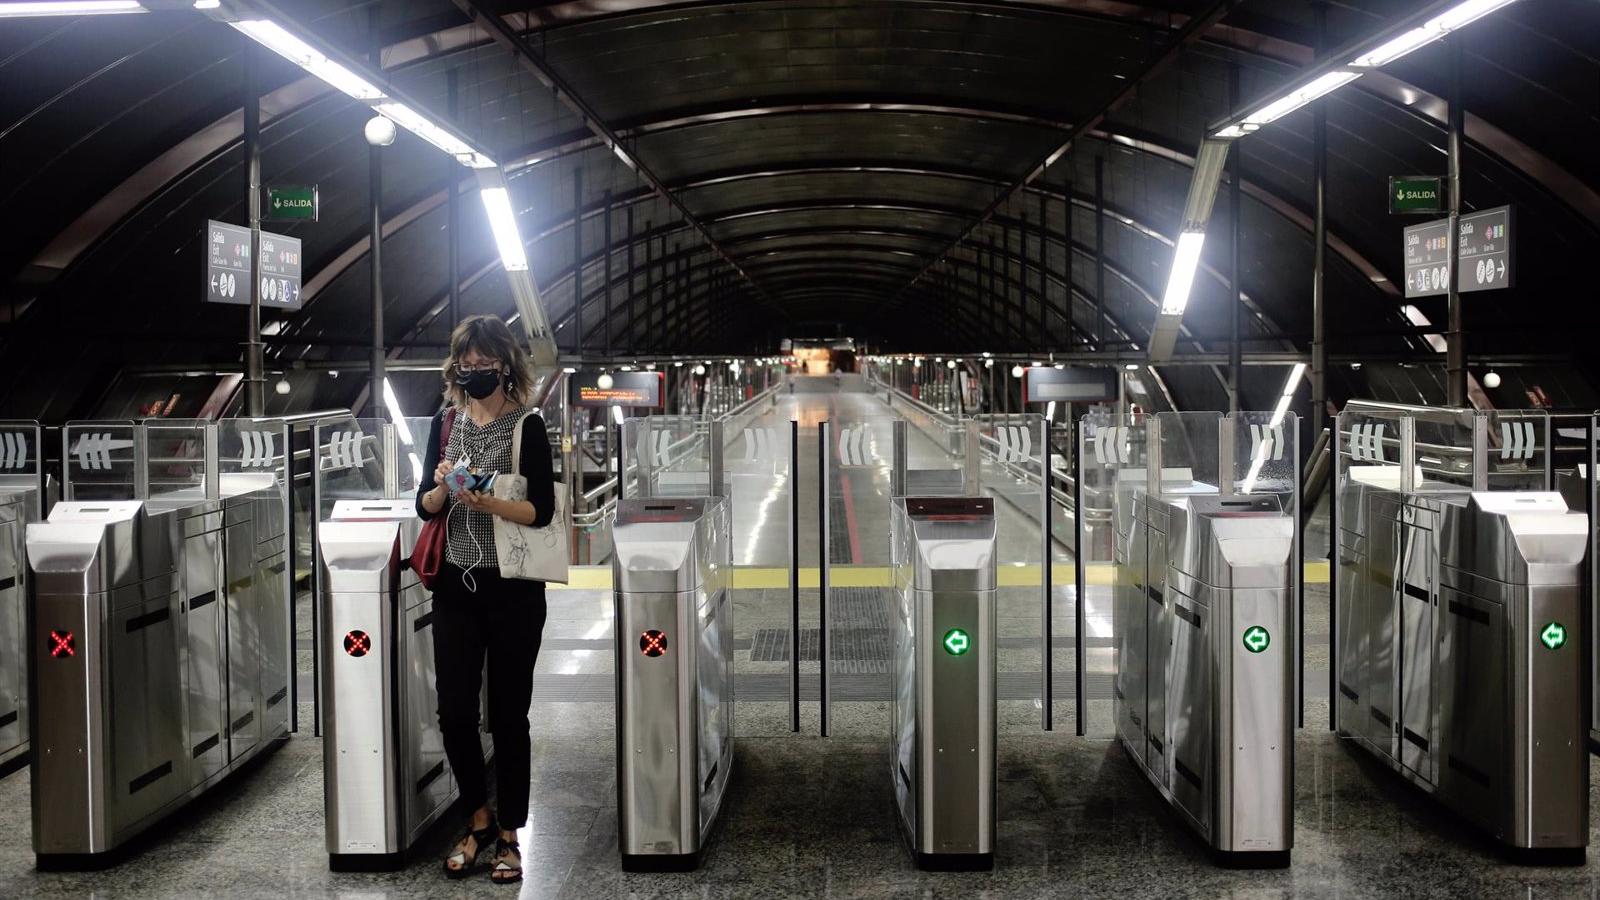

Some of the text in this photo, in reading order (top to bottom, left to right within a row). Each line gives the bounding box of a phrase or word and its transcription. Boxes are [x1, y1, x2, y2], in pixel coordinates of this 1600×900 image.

[1406, 191, 1436, 199] SALIDA
[283, 199, 312, 207] SALIDA
[1460, 223, 1473, 235] Salida
